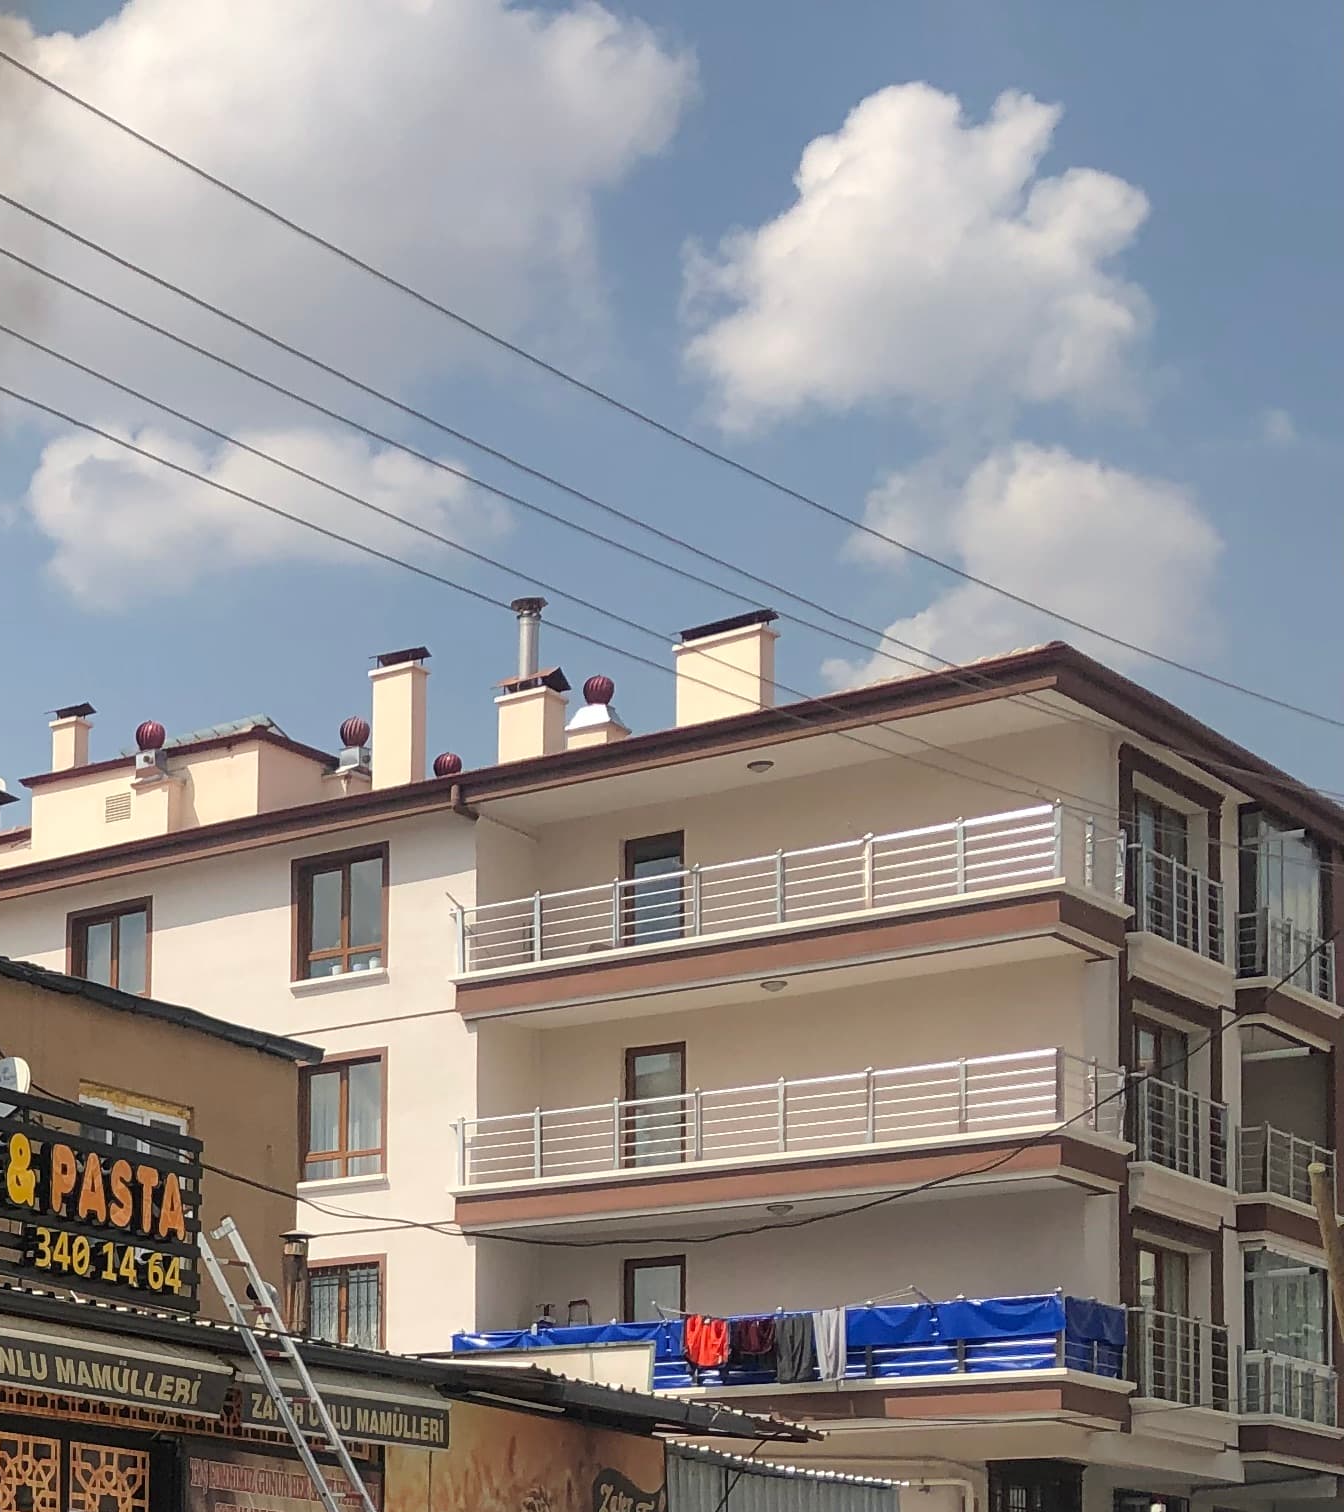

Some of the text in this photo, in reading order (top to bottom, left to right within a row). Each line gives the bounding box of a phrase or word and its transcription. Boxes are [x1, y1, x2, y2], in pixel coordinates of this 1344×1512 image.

[8, 1133, 36, 1207] &
[51, 1143, 185, 1240] PASTA
[34, 1228, 182, 1294] 340 14 64
[55, 1356, 202, 1405] MAMÜLLERİ
[357, 1408, 444, 1442] MAMÜLLERİ
